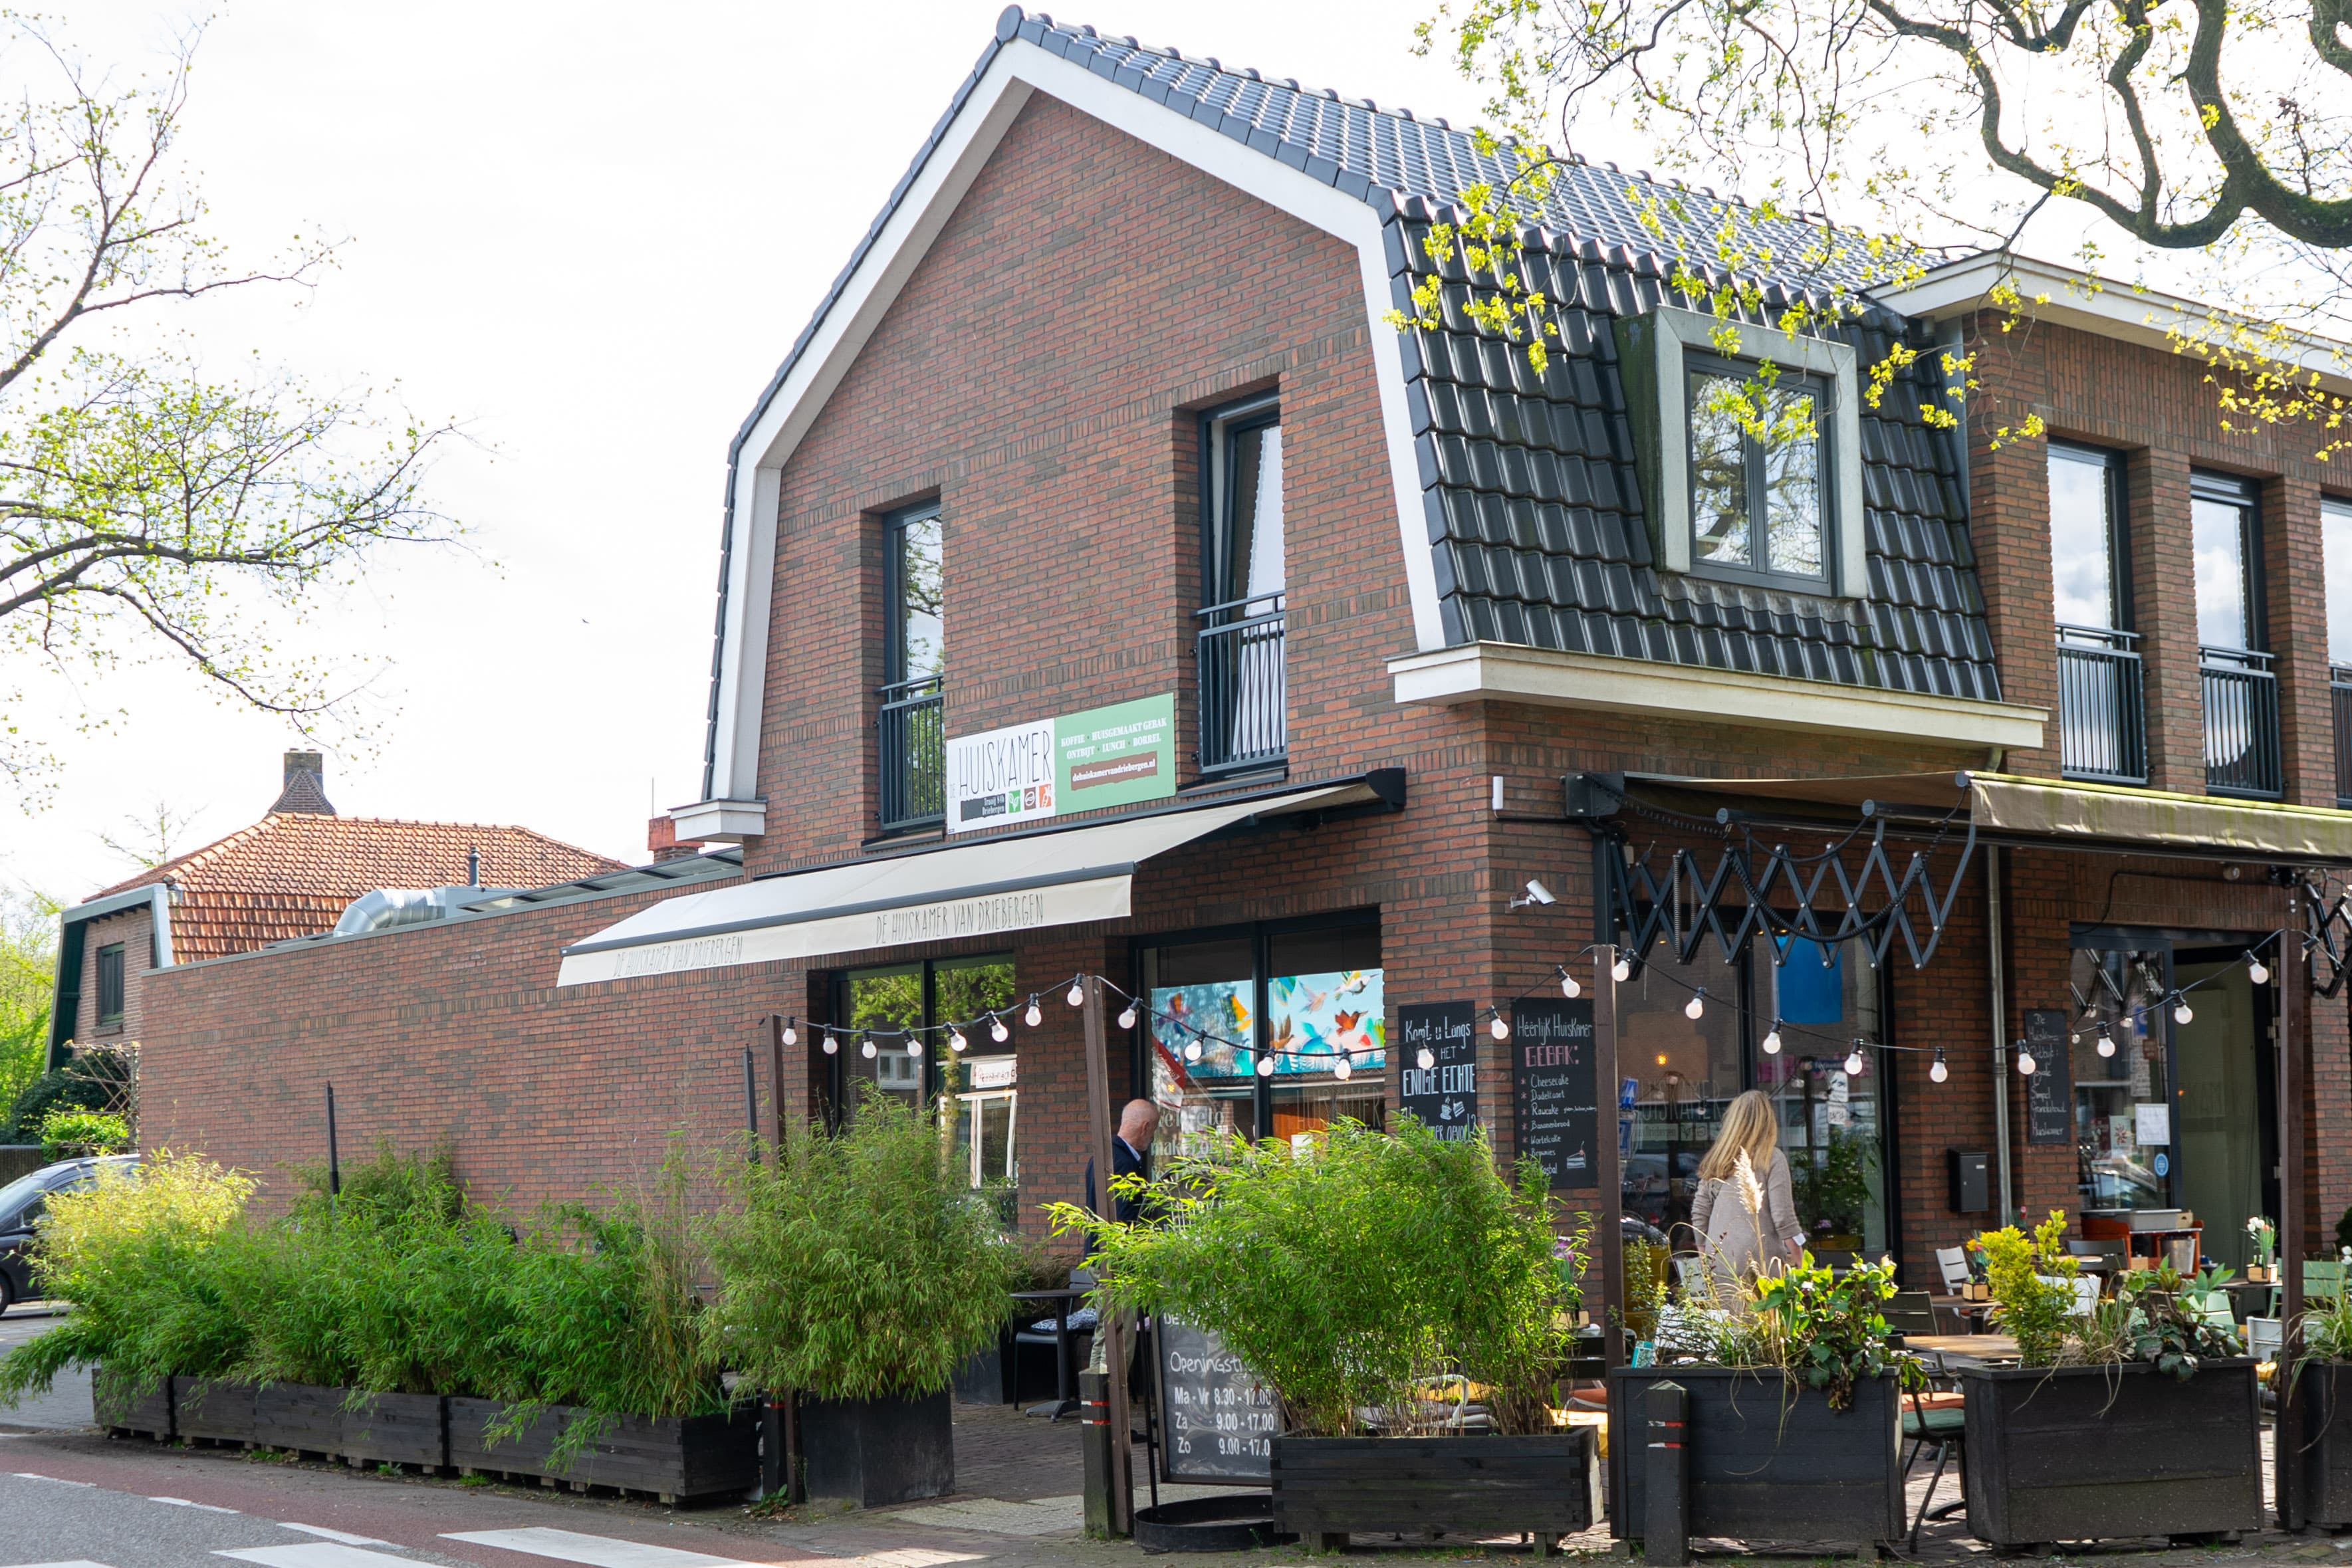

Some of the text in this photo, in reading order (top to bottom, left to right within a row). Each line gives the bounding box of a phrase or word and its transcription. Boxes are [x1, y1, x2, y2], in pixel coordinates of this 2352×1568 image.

[1061, 717, 1167, 747] KOFFIE HUISGEMAAKT GEBAK
[1066, 732, 1161, 760] ONTBIJT LUNCH BORREL
[959, 730, 1052, 796] HUISKAMER
[876, 893, 1043, 944] DE HUISKAMER VAN DRIEBERGEN
[613, 936, 743, 977] DE HUISKAMER VAN DRIEBERGEN
[1441, 1046, 1457, 1060] HET
[1403, 1064, 1476, 1097] ENIGE ECHTE
[1530, 1073, 1569, 1088] Cheesecake
[1175, 1386, 1190, 1404] Ma
[1197, 1387, 1210, 1404] Vr
[1214, 1387, 1235, 1405] 8.30
[1244, 1388, 1272, 1406] 17.00
[1175, 1412, 1189, 1429] Za
[1216, 1413, 1238, 1430] 9.00
[1247, 1413, 1274, 1431] 17.00
[1177, 1436, 1191, 1454] Zo
[1218, 1438, 1240, 1455] 9.00
